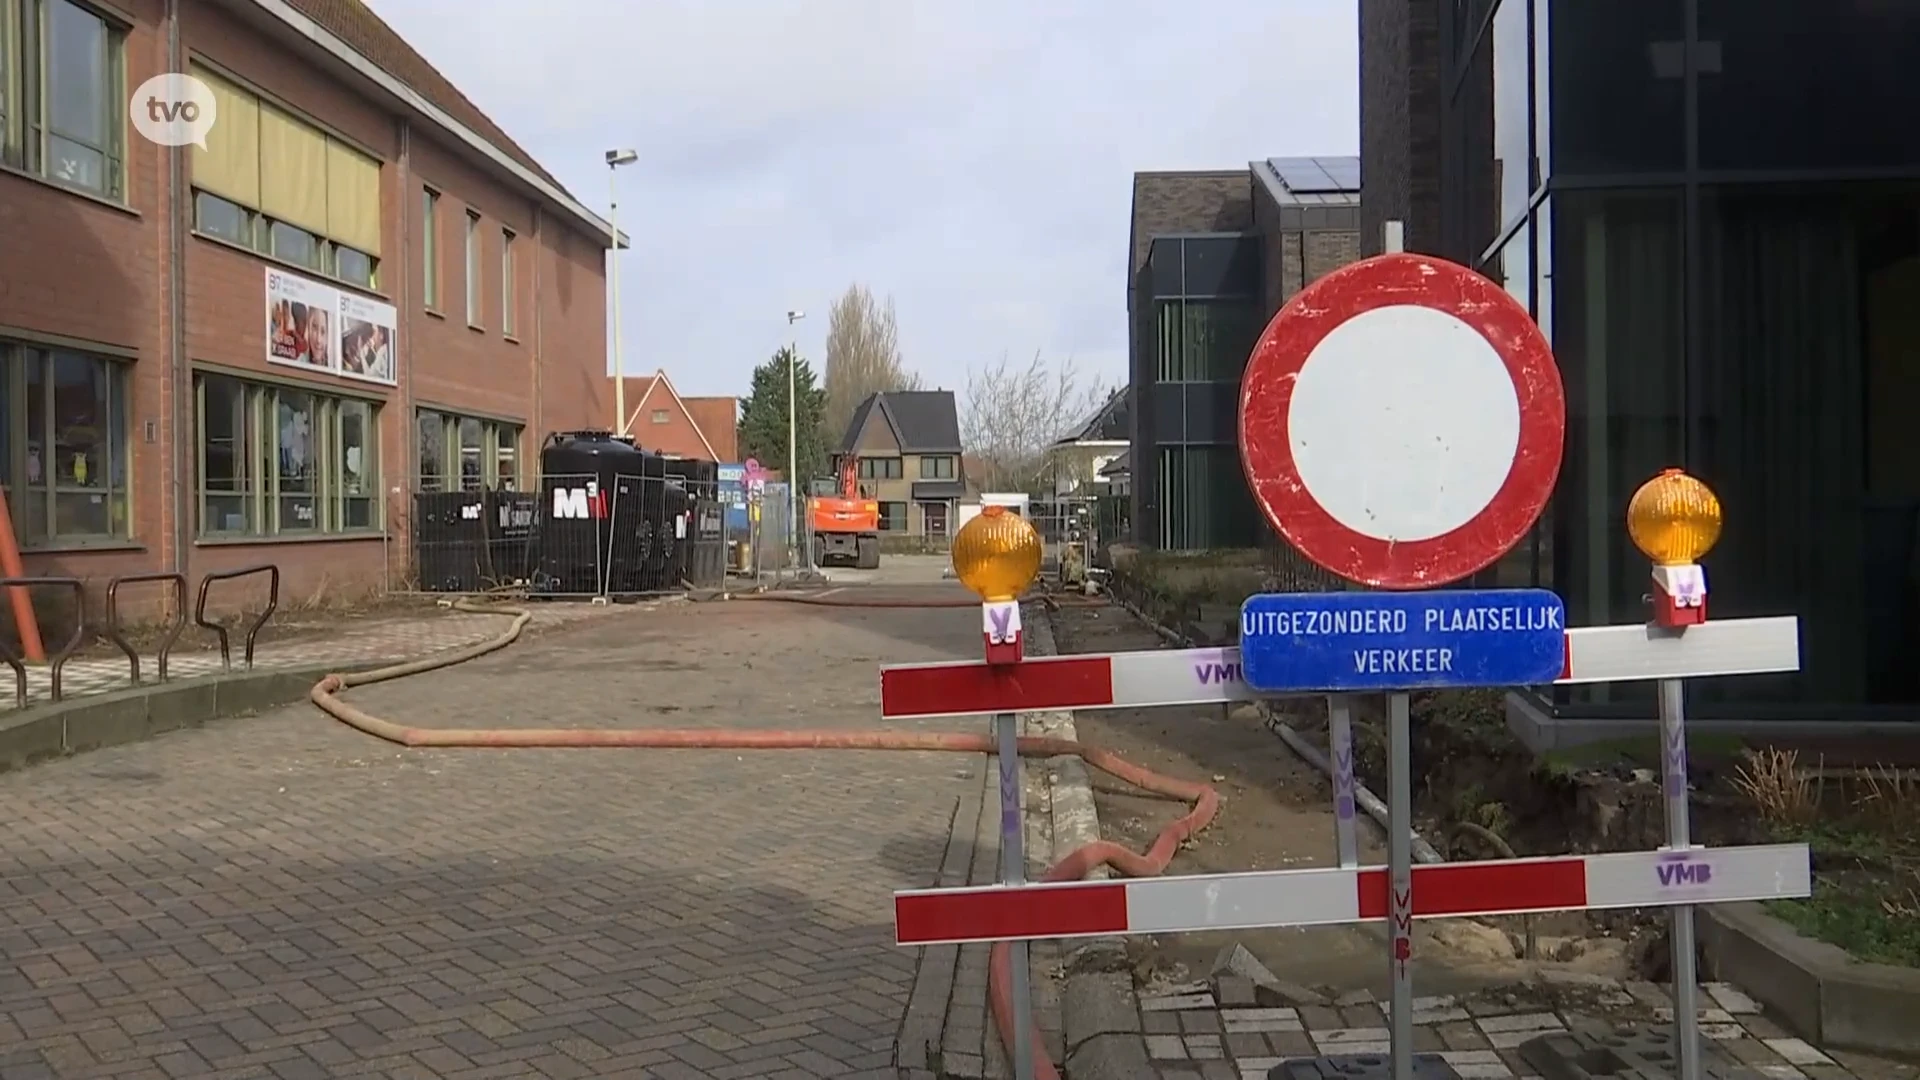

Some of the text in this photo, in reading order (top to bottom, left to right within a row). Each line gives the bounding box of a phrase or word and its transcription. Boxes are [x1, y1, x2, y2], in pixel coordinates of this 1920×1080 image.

[1242, 605, 1561, 635] UITGEZONDERD PLAATSELIJK
[1354, 648, 1453, 674] VERKEER
[1656, 863, 1712, 886] VMB
